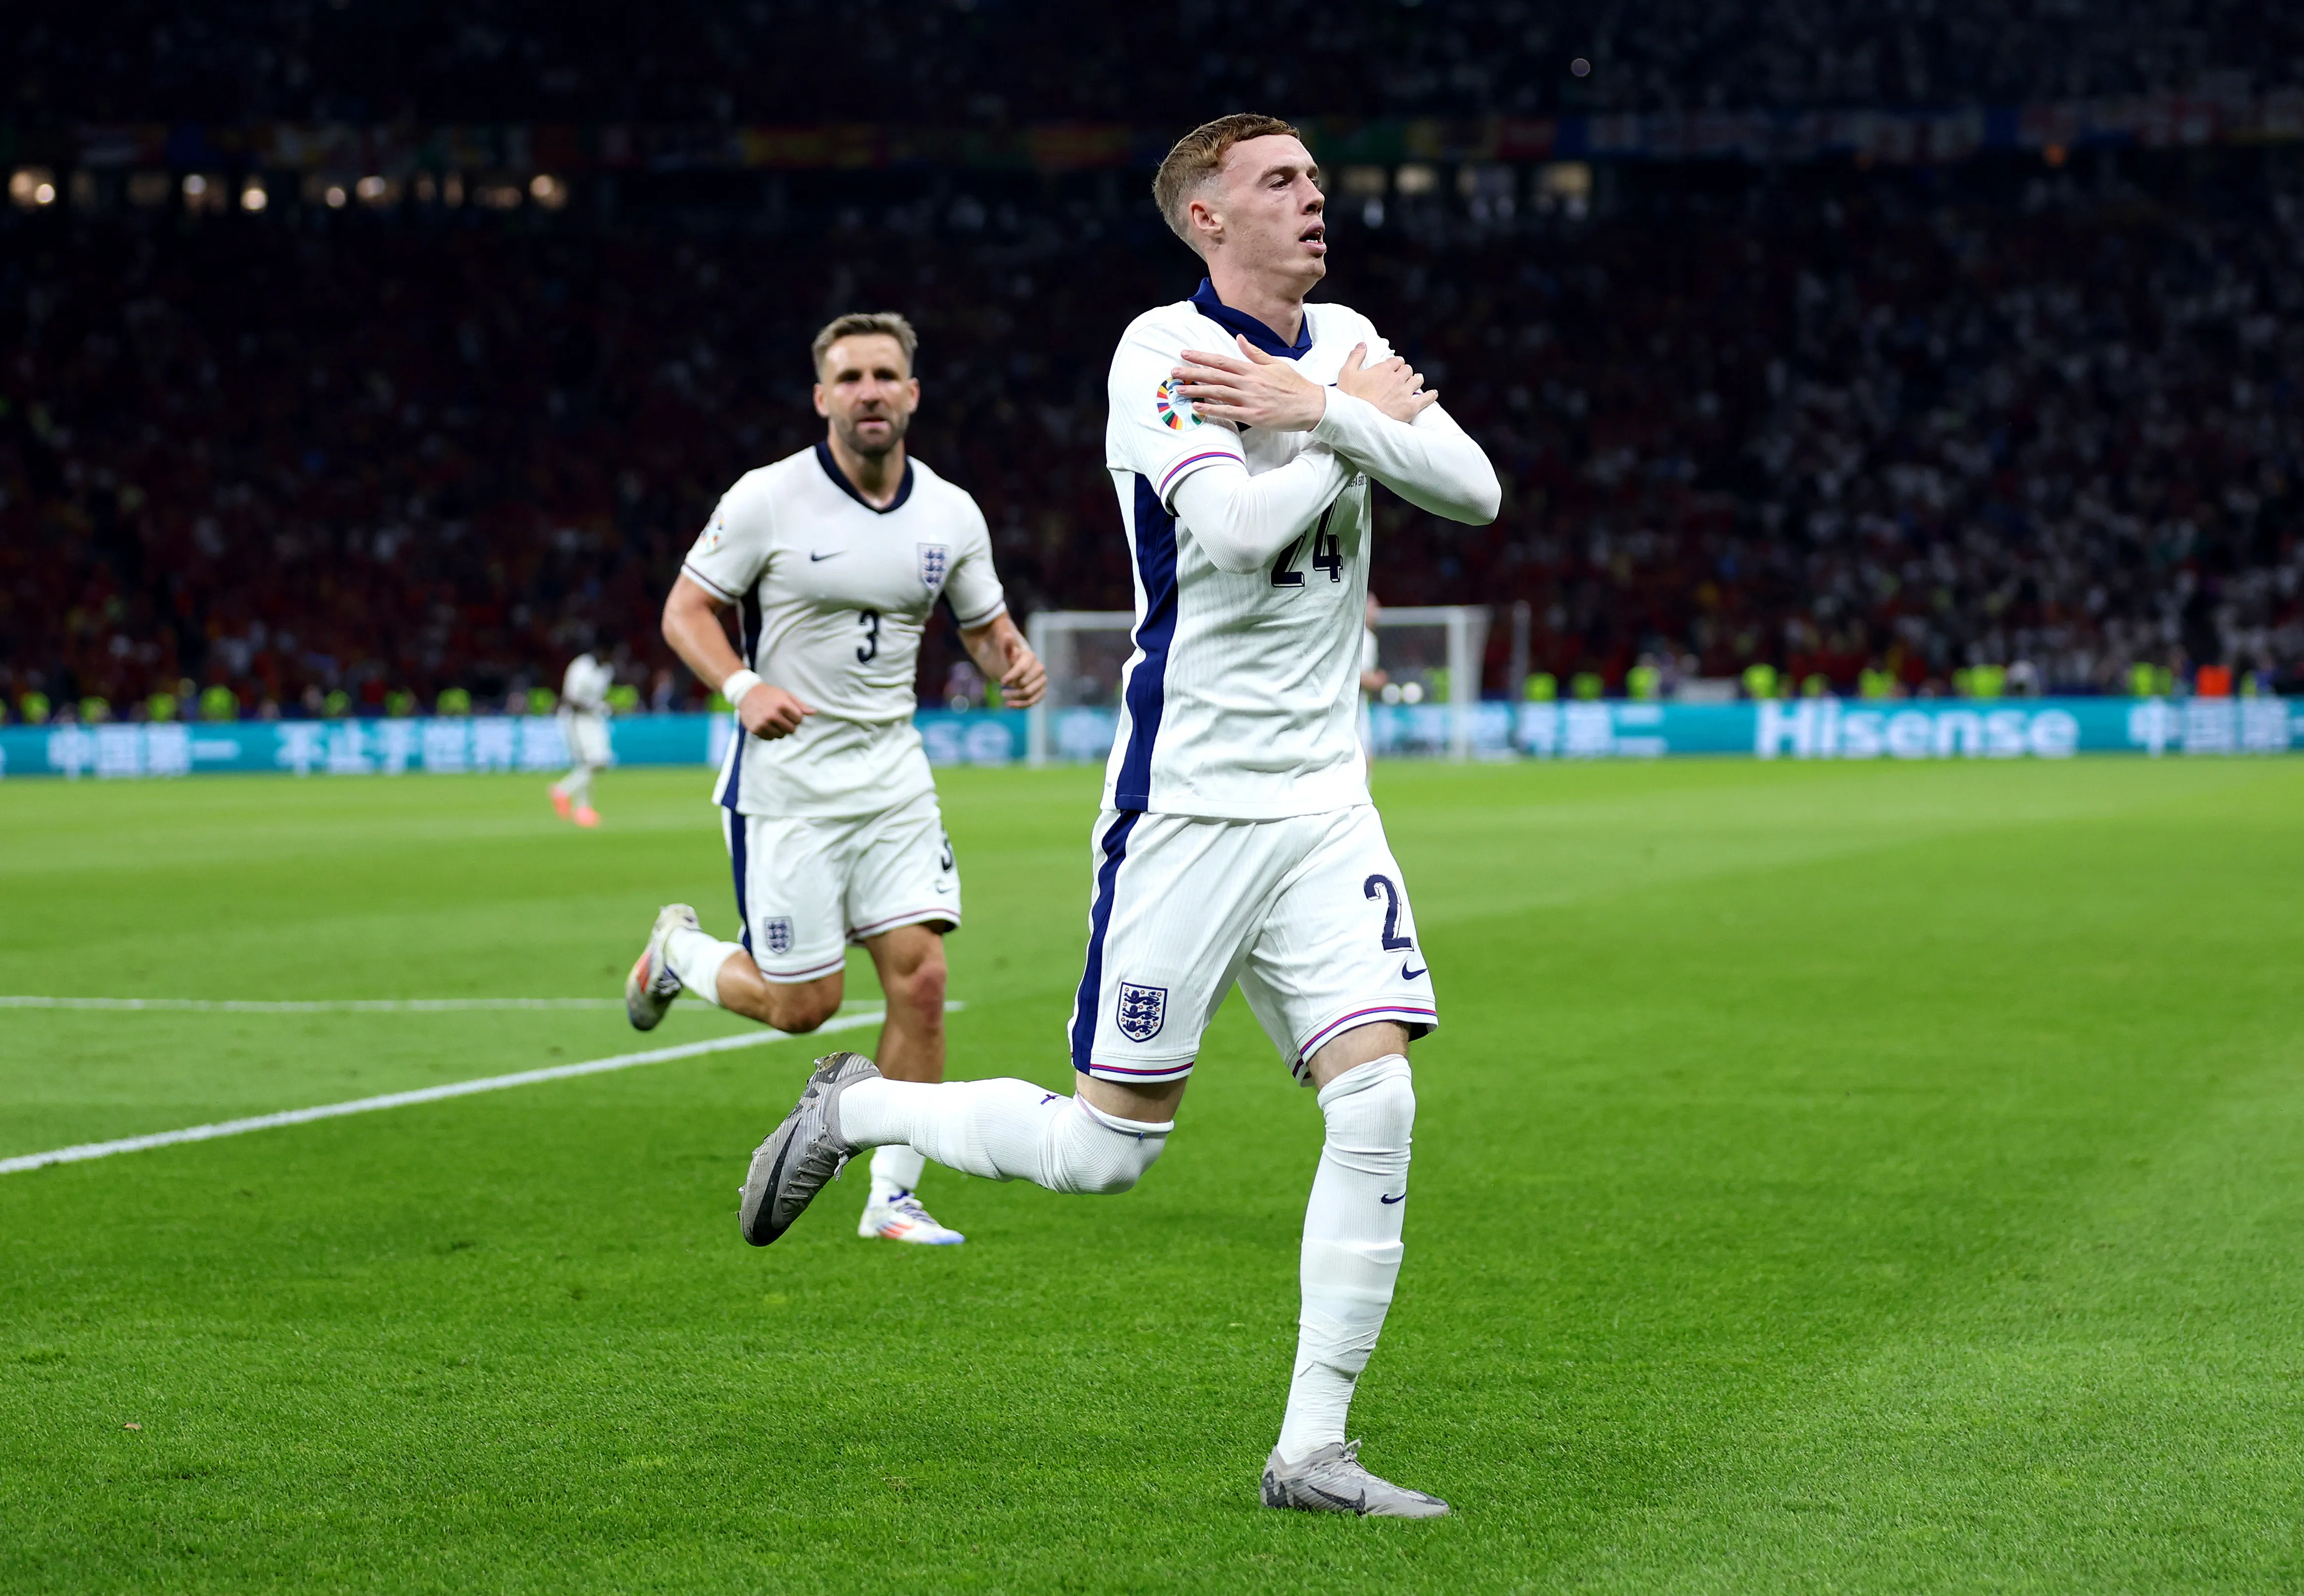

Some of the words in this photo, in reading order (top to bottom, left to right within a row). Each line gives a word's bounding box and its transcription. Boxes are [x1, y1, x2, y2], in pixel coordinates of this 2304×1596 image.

[857, 608, 880, 664] 3
[1755, 694, 2079, 759] Hisense
[1363, 873, 1414, 953] 2
